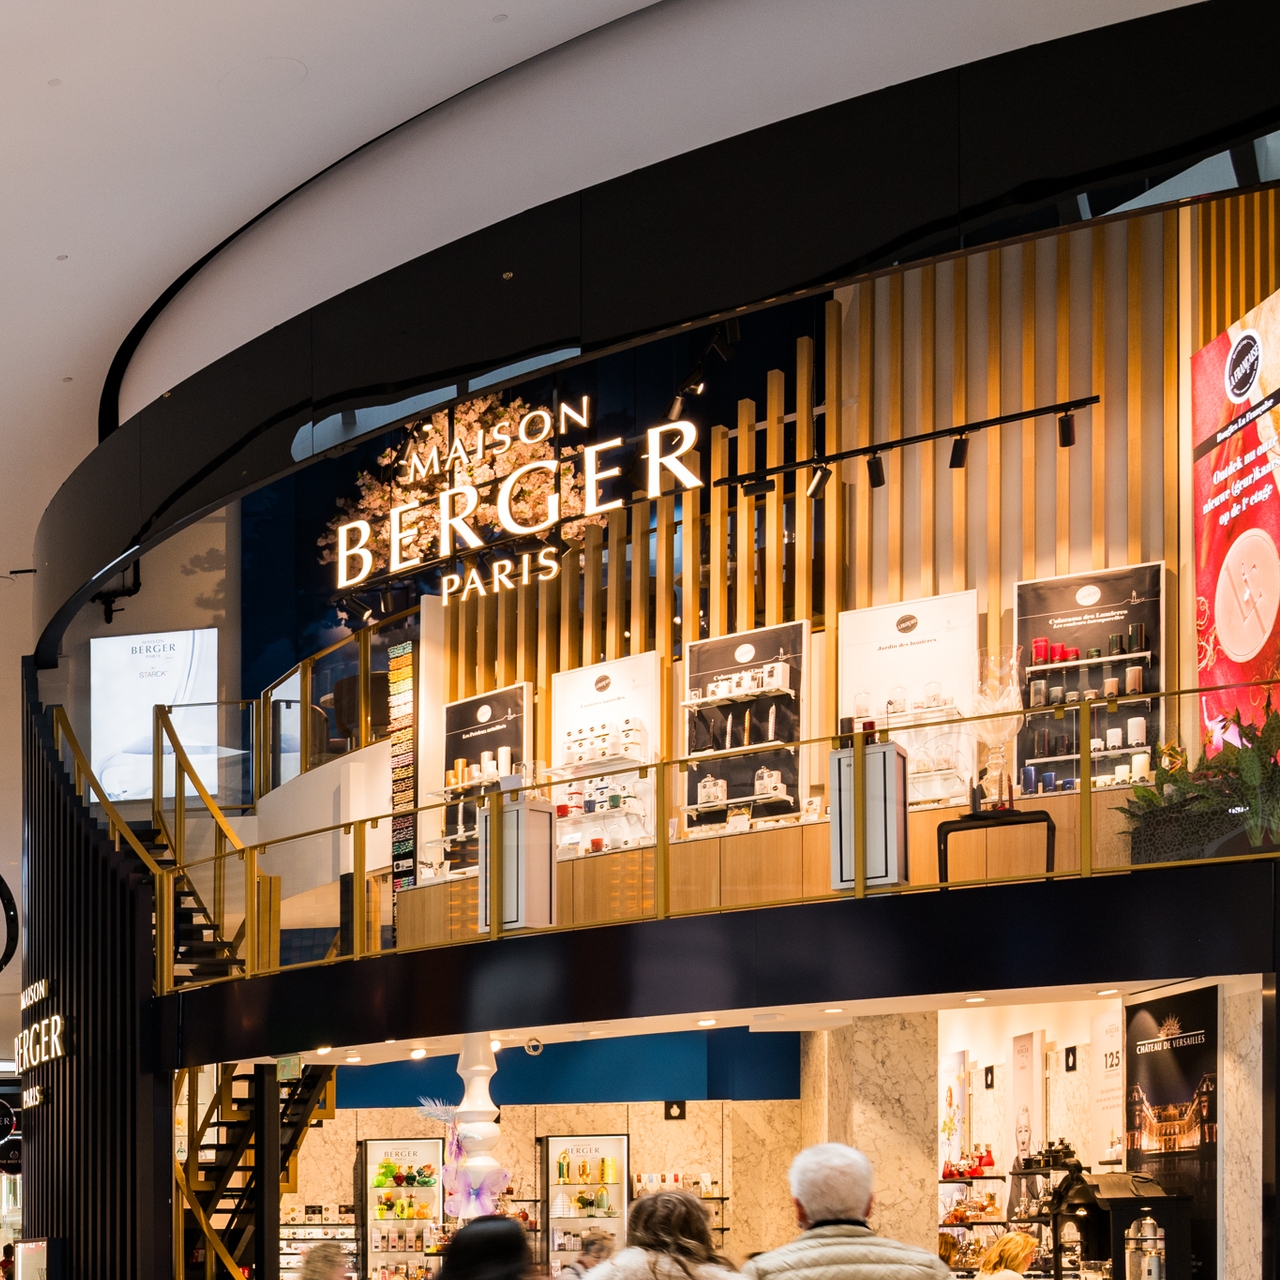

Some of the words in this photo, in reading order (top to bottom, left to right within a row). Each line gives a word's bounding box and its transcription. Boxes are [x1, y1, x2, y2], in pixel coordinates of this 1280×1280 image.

[407, 394, 592, 483] MAISON
[1213, 455, 1243, 485] Ontdek
[1243, 448, 1256, 464] nu
[1256, 435, 1279, 457] onze
[336, 419, 705, 590] BERGER
[1202, 489, 1231, 515] nieuwe
[1218, 508, 1230, 526] op
[1230, 502, 1241, 518] de
[1249, 483, 1274, 506] etage
[440, 545, 560, 607] PARIS
[131, 643, 176, 655] BERGER
[139, 670, 167, 678] STARCK
[14, 1014, 65, 1076] BERGER
[1136, 1043, 1162, 1055] CHÂTEAU
[1162, 1041, 1171, 1050] DE
[1171, 1034, 1205, 1049] VERSAILLES
[1104, 1050, 1121, 1069] 125
[23, 1086, 40, 1109] PARIS
[384, 1150, 418, 1158] BERGER
[564, 1147, 601, 1155] BERGER
